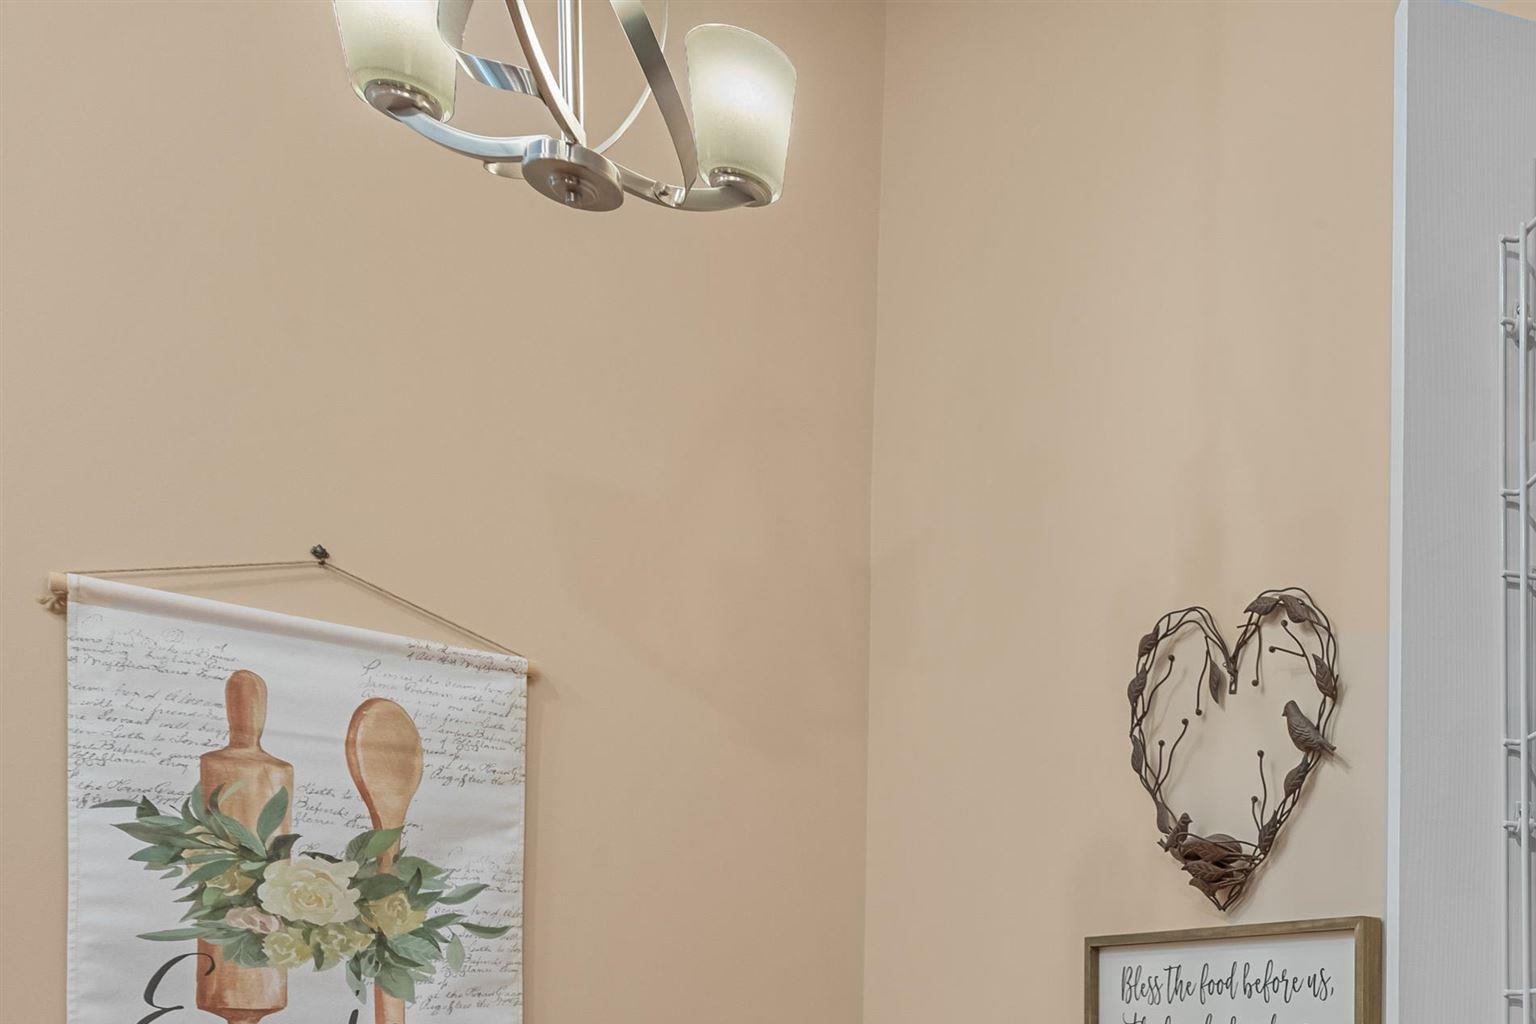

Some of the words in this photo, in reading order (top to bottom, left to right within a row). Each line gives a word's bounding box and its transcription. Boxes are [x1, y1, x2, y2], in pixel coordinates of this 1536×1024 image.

[1121, 965, 1162, 1005] Bless
[1195, 962, 1238, 1004] food
[1243, 959, 1306, 1003] before
[1306, 967, 1335, 1001] us,
